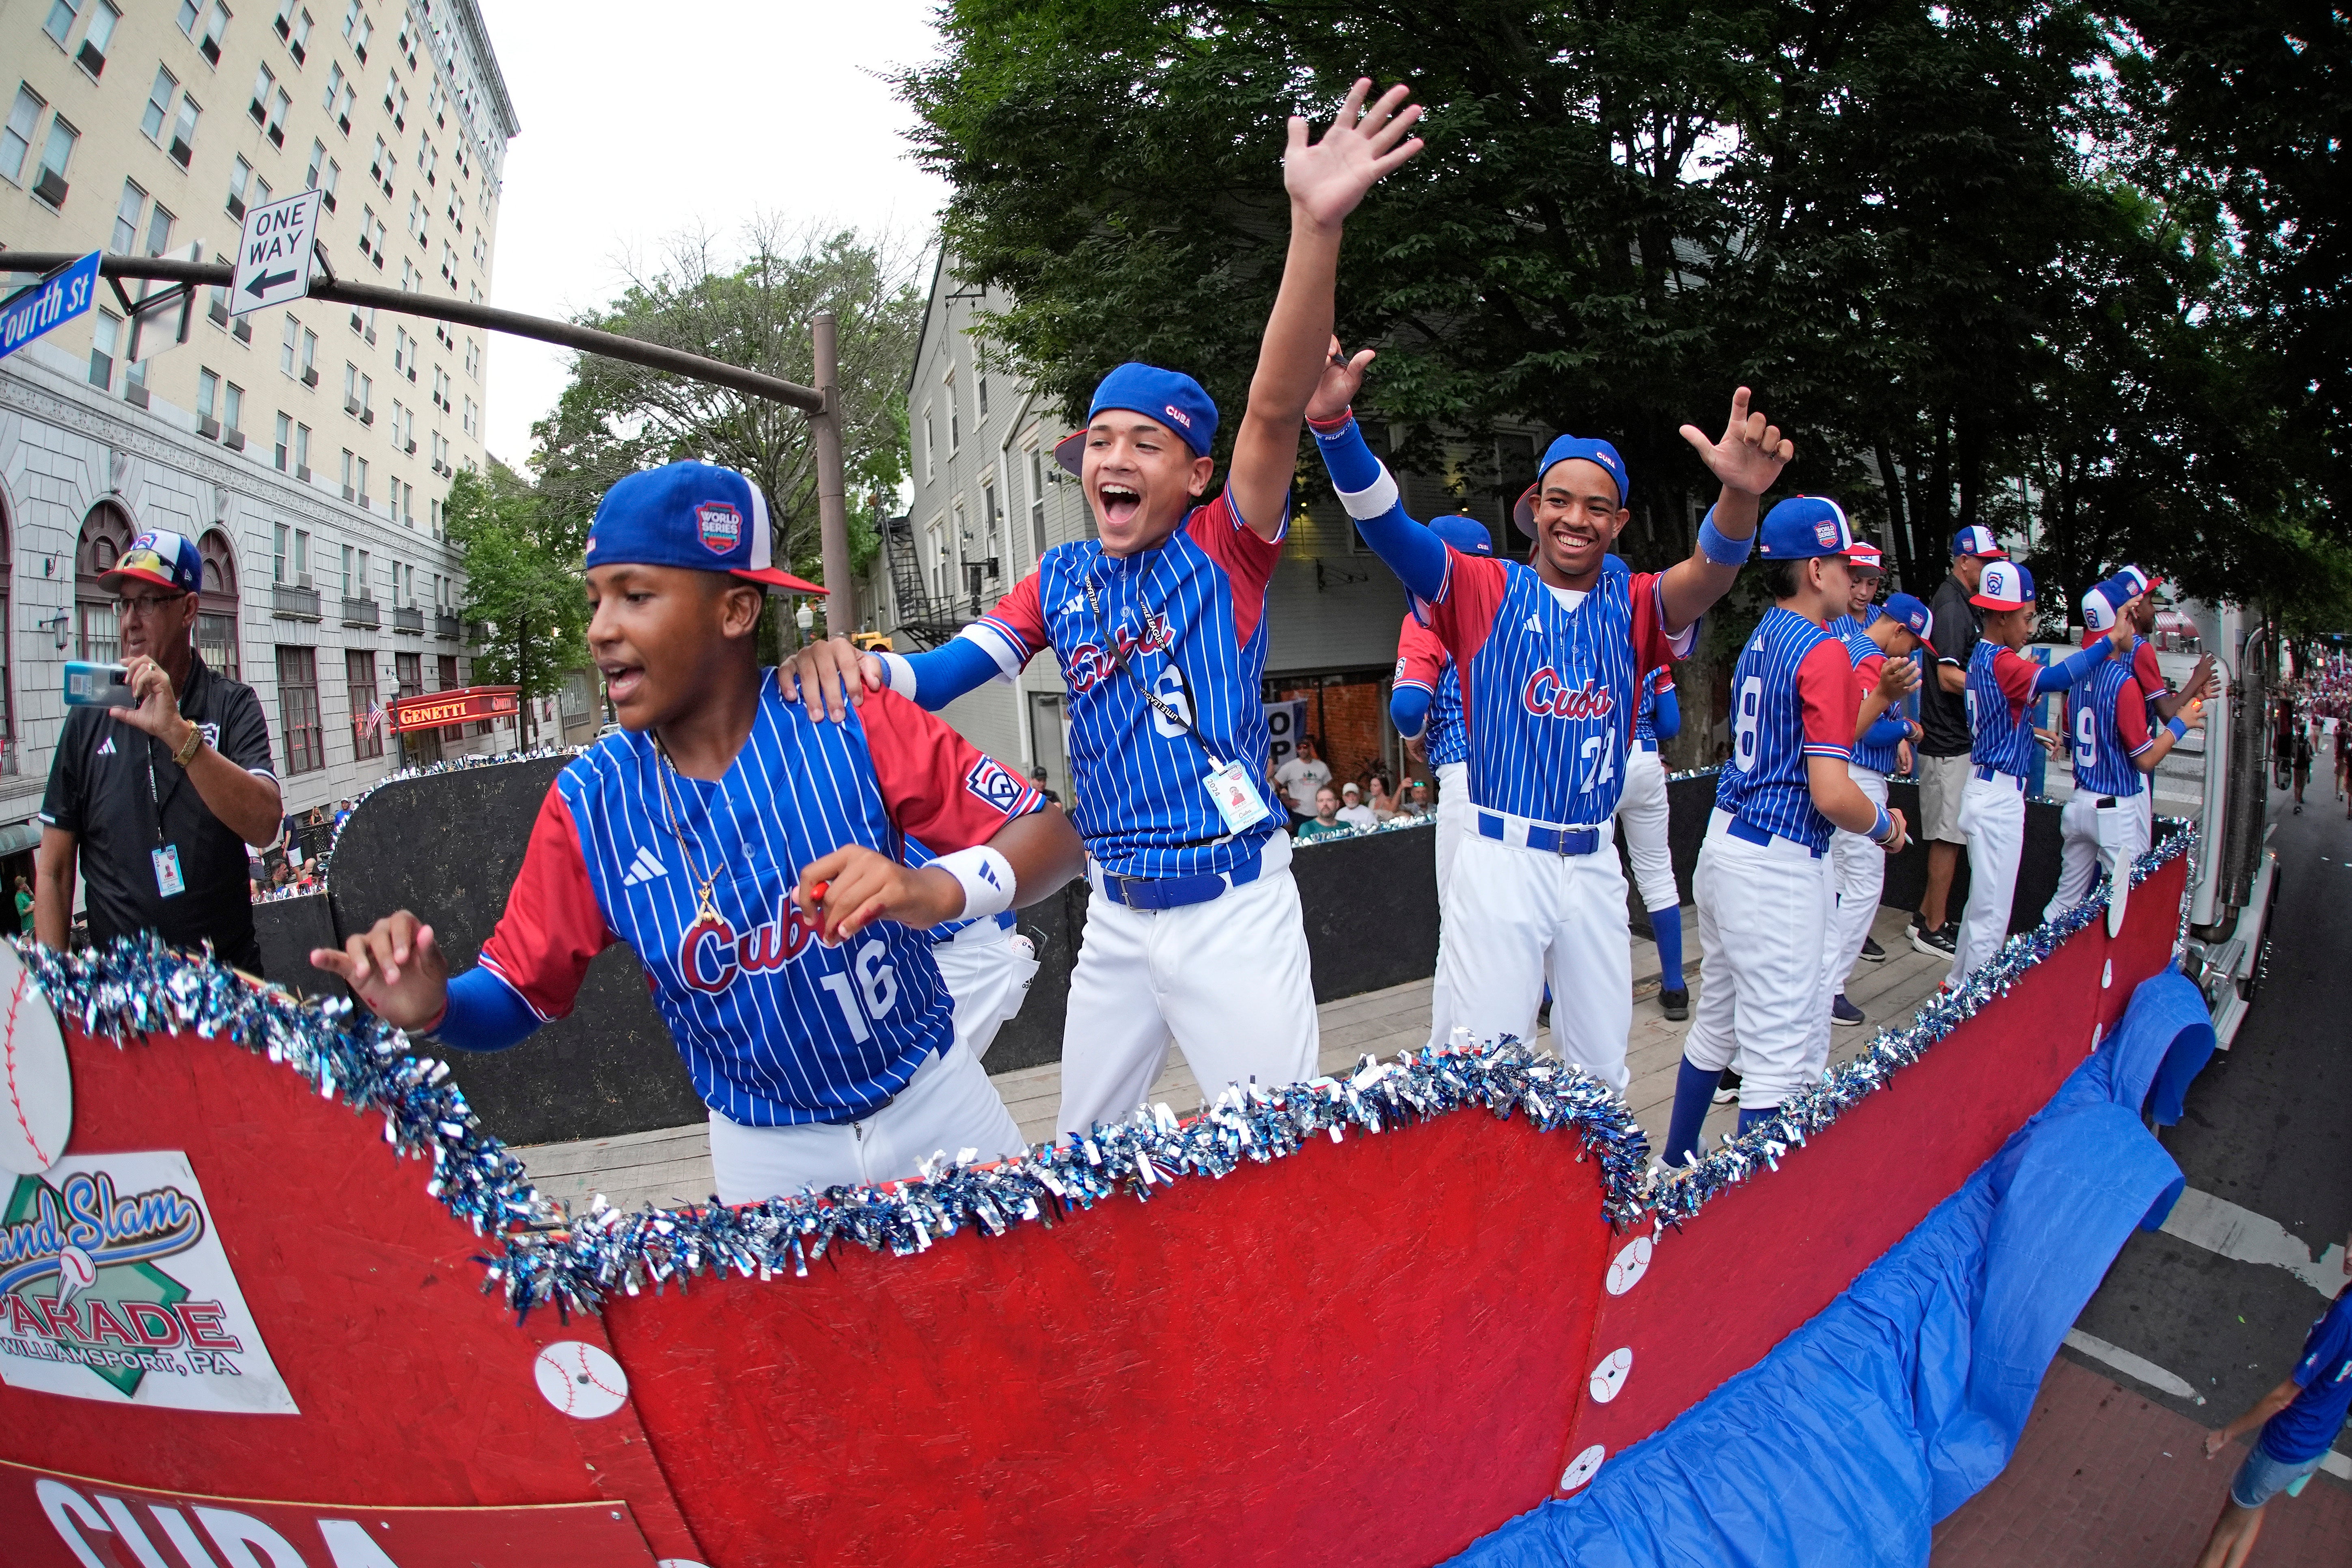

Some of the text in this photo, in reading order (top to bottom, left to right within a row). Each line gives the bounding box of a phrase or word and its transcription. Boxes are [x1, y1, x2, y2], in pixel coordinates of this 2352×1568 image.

[256, 202, 306, 236] ONE
[250, 230, 303, 266] WAY
[67, 273, 89, 312] St
[1165, 405, 1191, 429] CUBA
[1596, 452, 1616, 469] CUBA
[700, 511, 739, 525] WORLD
[702, 521, 738, 535] SERIES
[1815, 525, 1835, 533] WORLD
[1818, 530, 1835, 539] SERIES
[1090, 597, 1099, 613] LITTLE
[1153, 663, 1192, 739] 6
[1522, 665, 1615, 721] Cuba
[400, 702, 467, 725] GENETTI
[1160, 704, 1179, 721] LITTLE
[1733, 675, 1761, 774] 8
[2075, 706, 2097, 768] 9
[1579, 727, 1616, 794] 22
[1207, 779, 1220, 796] 2024
[1239, 809, 1252, 819] Cuba
[678, 890, 844, 996] Cub
[820, 939, 897, 1045] 16
[65, 1172, 203, 1250] Slam
[189, 1352, 242, 1376] PA
